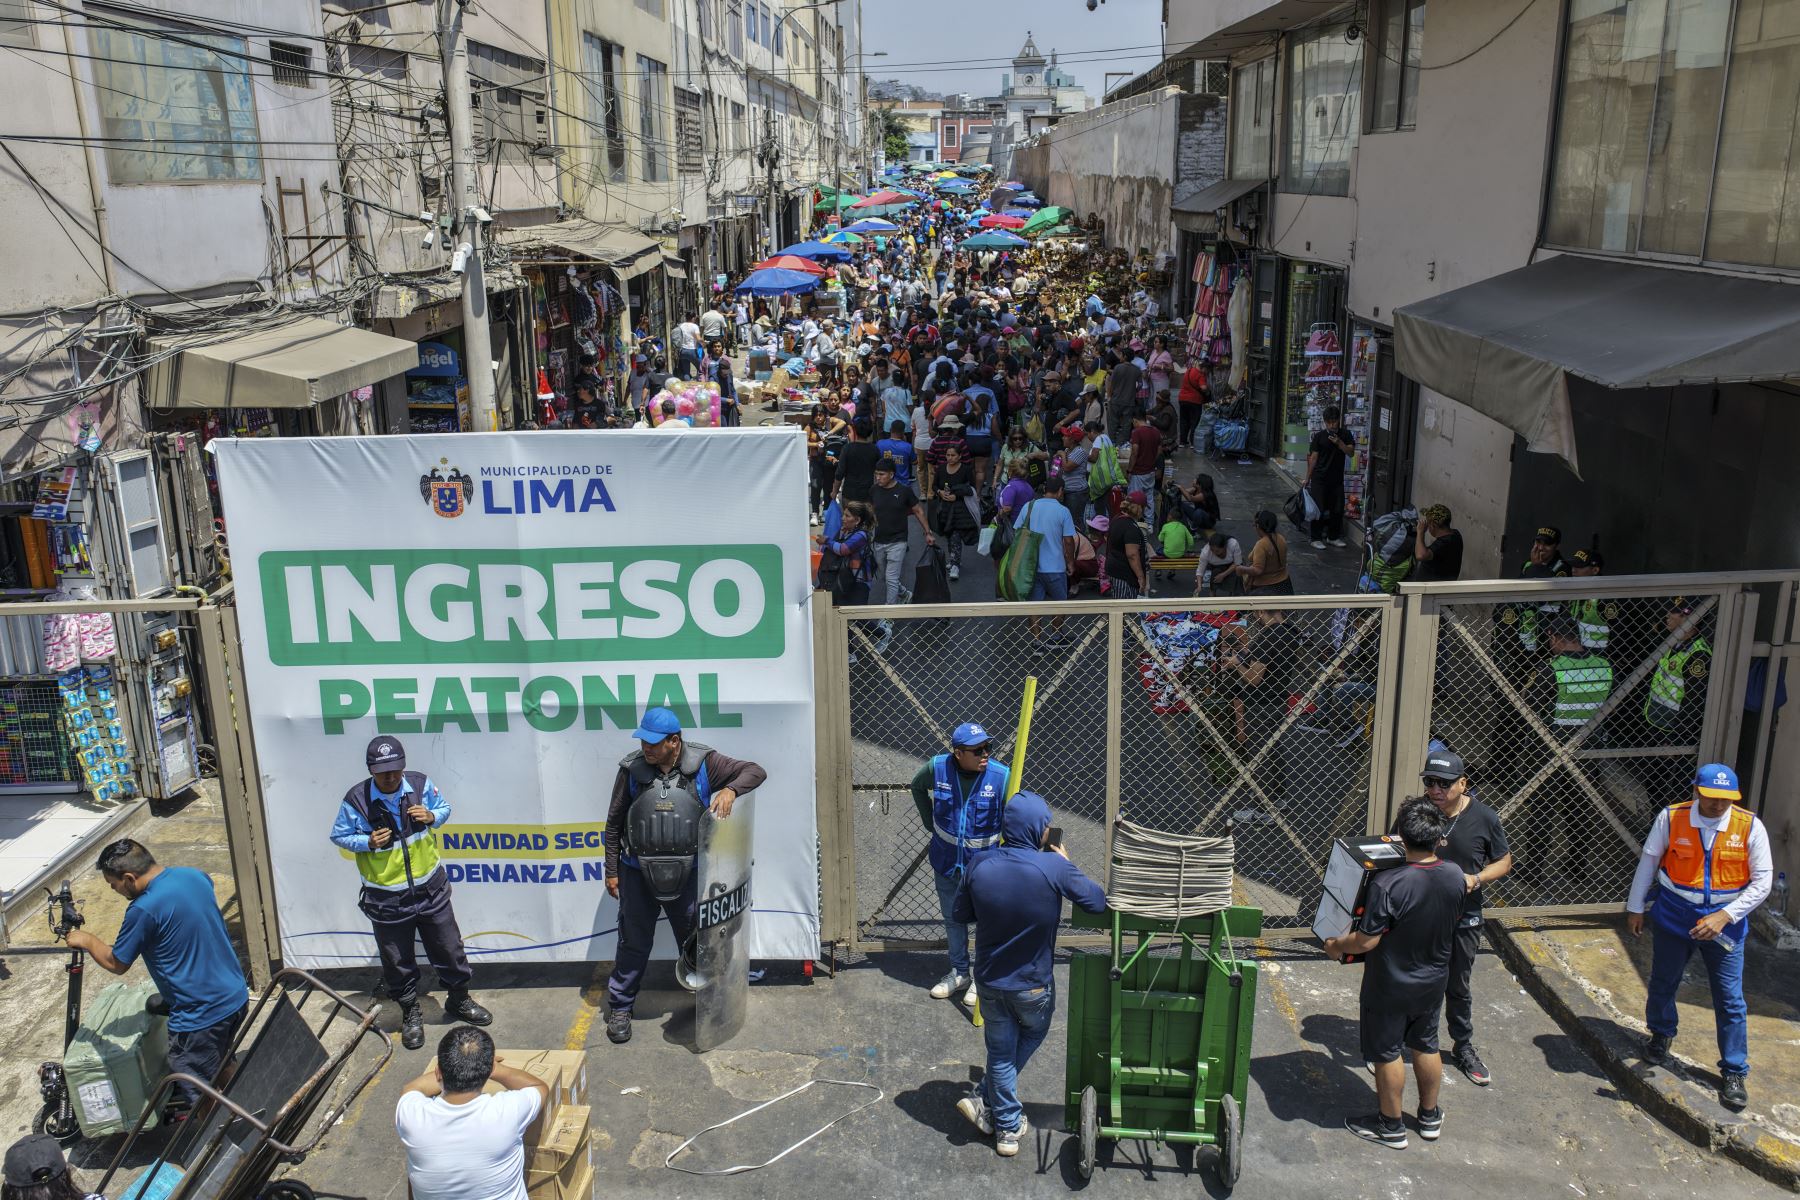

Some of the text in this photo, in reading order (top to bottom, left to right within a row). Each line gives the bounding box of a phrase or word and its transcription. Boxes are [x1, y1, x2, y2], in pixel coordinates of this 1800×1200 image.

[419, 350, 453, 367] ngel
[480, 465, 613, 476] MUNICIPALIDAD DE
[482, 478, 616, 514] LIMA
[284, 558, 766, 644] INGRESO
[319, 673, 743, 735] PEATONAL
[443, 833, 549, 850] NAVIDAD
